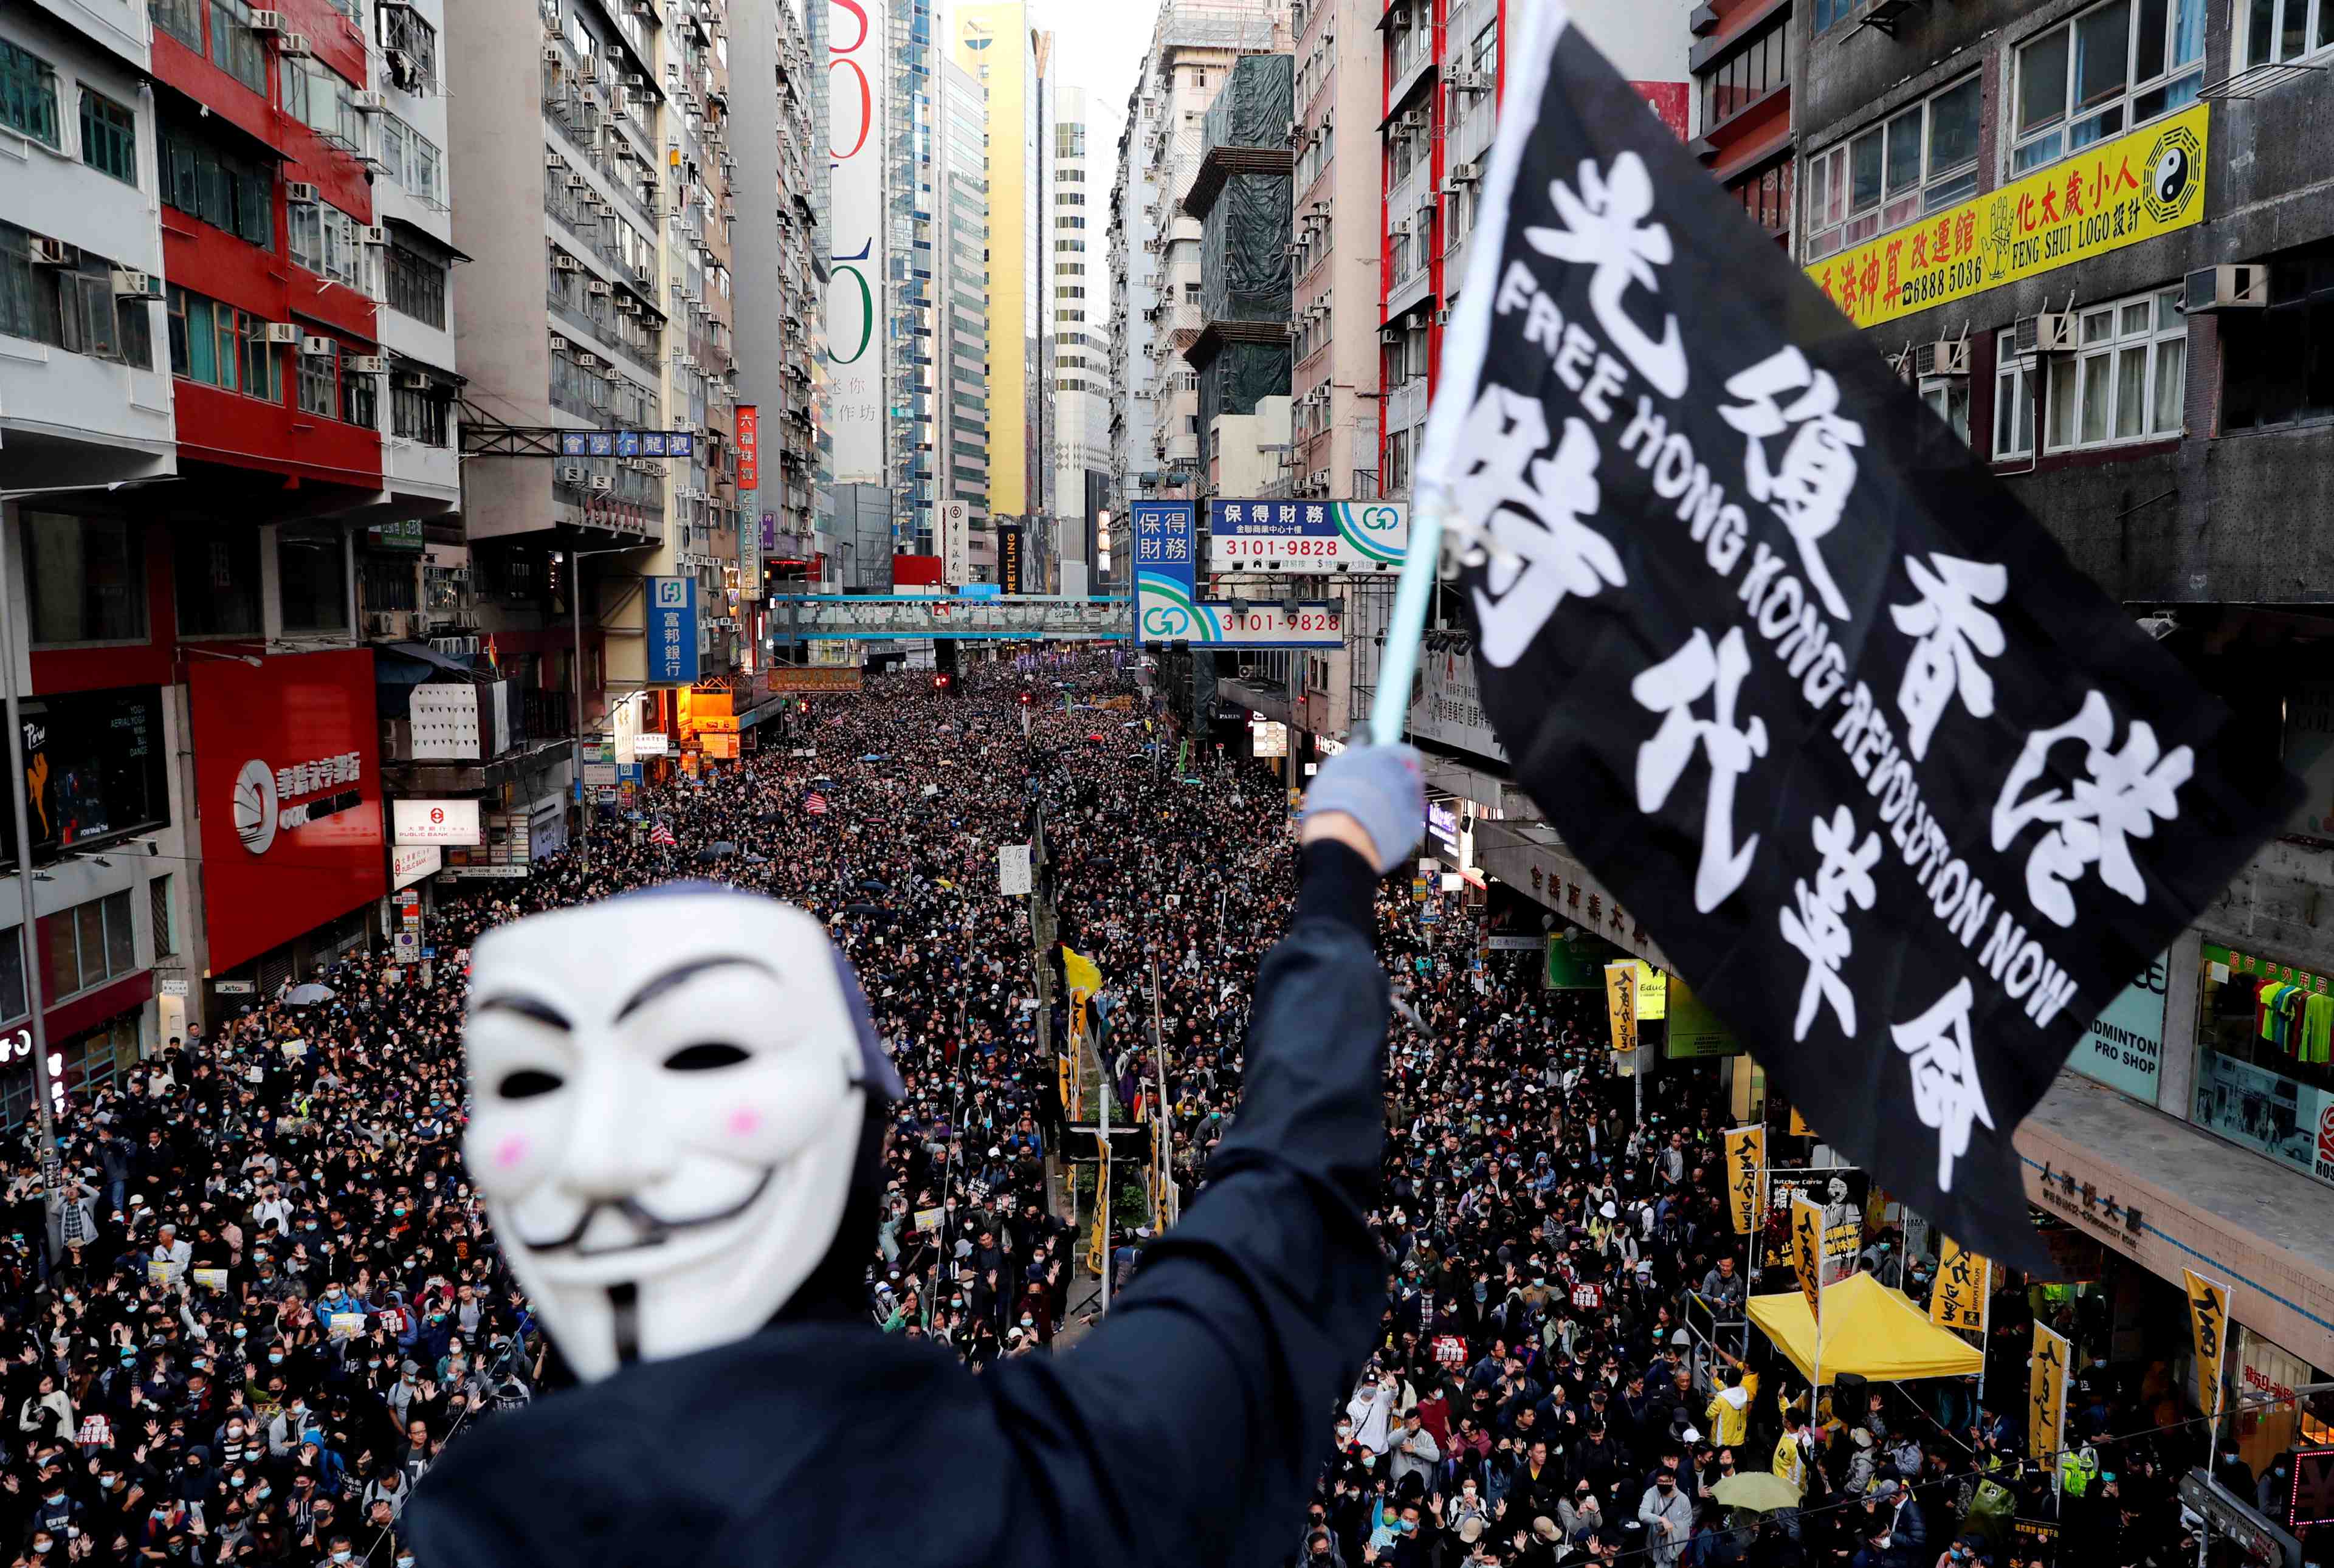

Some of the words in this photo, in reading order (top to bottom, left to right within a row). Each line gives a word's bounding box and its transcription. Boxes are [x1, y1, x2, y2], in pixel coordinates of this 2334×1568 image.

[2017, 156, 2139, 236] 化太歲小人
[1911, 209, 1975, 271] 改運館
[2012, 236, 2039, 270] FENG
[2045, 224, 2071, 259] SHUI
[2078, 211, 2109, 249] LOGO
[2113, 197, 2140, 238] 設計
[1914, 269, 1944, 303] 6888
[1949, 256, 1981, 292] 5036
[839, 405, 875, 422] 作坊
[740, 414, 753, 480] 六福珠寶
[1224, 504, 1324, 523] 保得財務
[1236, 525, 1303, 534] 金聯商業中心十樓
[1227, 540, 1337, 555] 3101-9828
[1523, 150, 2195, 929] 光復香港
[1222, 614, 1339, 631] 3101-9828
[664, 613, 680, 676] 富邦銀行
[1495, 260, 1628, 423] FREE
[1619, 395, 1748, 576] HONG
[1737, 541, 1847, 709] KONG
[1832, 681, 1996, 949] REVOLUTION
[1978, 912, 2078, 1029] NOW
[130, 746, 148, 757] DANCE
[2229, 951, 2254, 972] 旅行
[2266, 962, 2327, 994] 戶外用品
[2095, 1040, 2118, 1060] PRO
[2122, 1052, 2155, 1074] SHOP
[2236, 1516, 2256, 1536] Road
